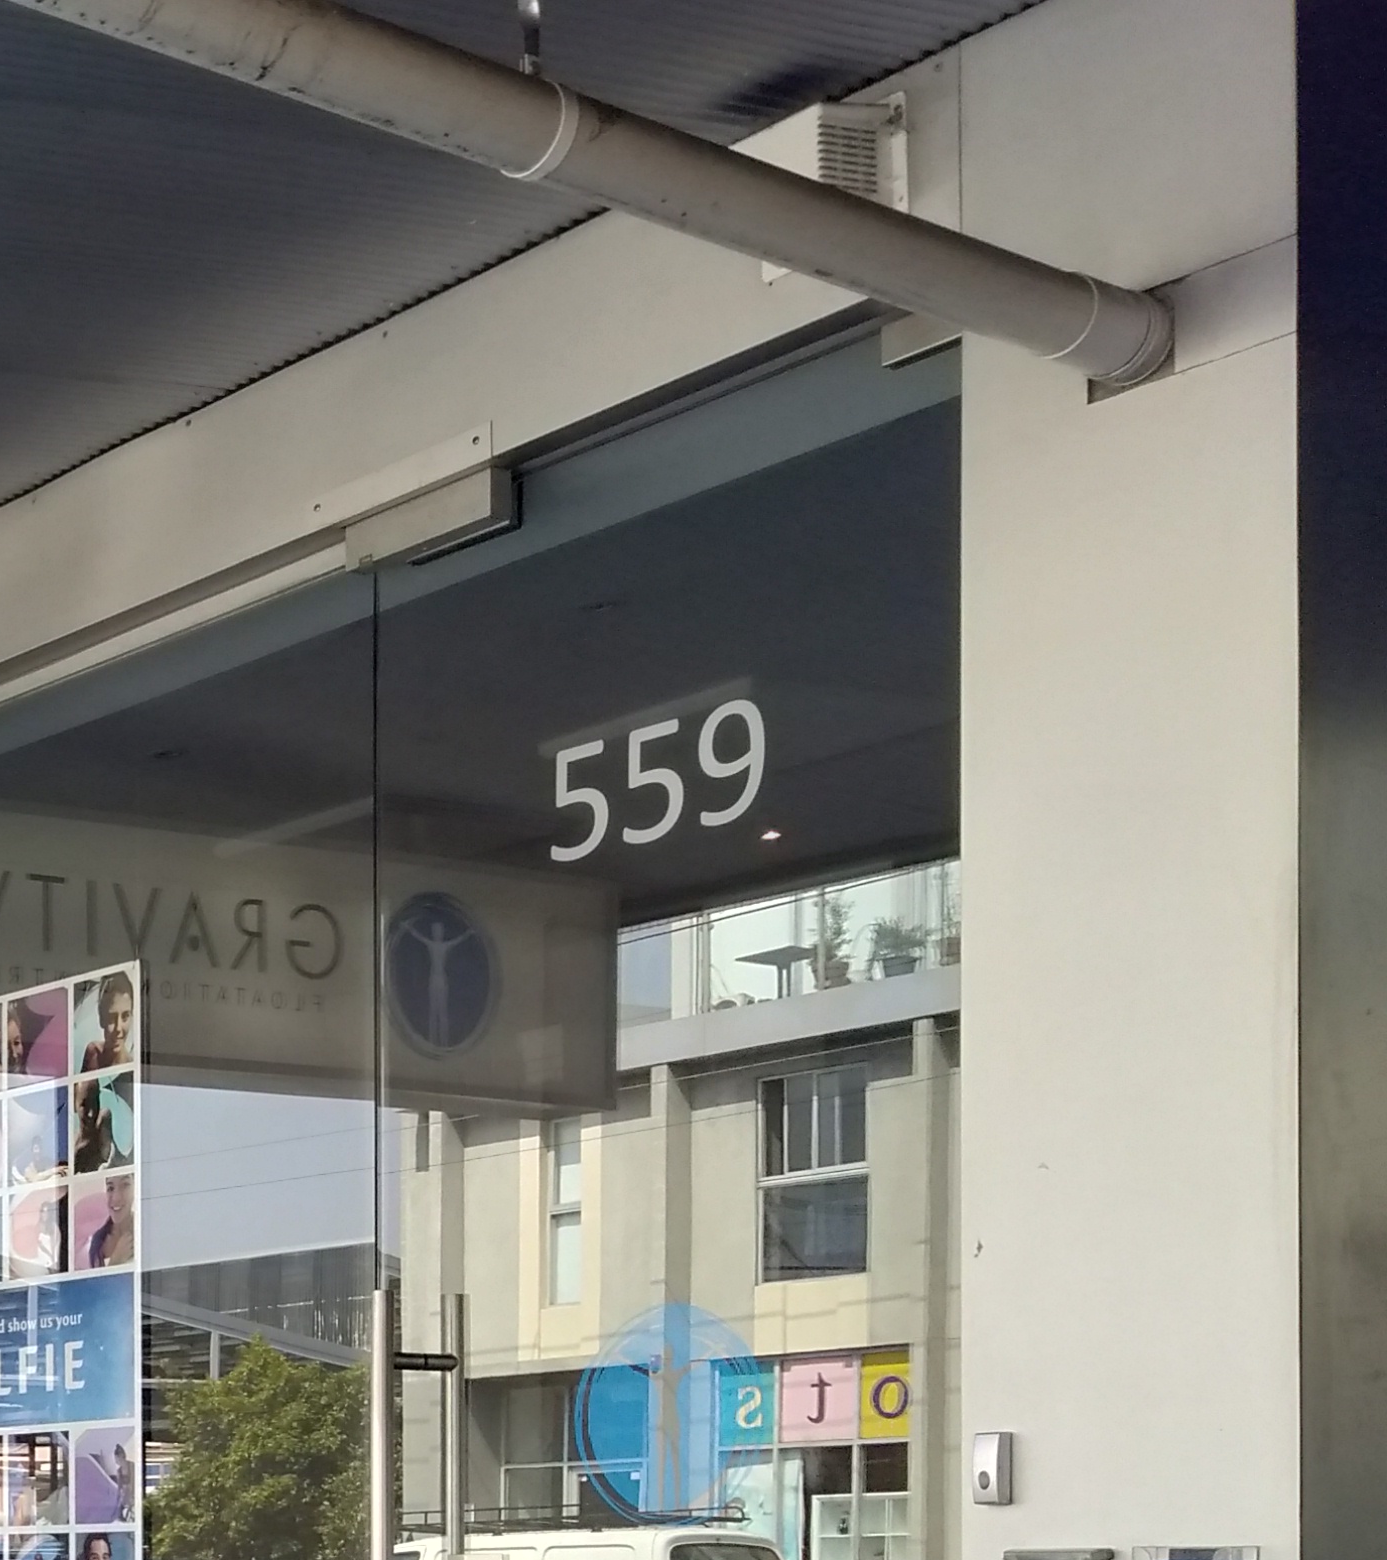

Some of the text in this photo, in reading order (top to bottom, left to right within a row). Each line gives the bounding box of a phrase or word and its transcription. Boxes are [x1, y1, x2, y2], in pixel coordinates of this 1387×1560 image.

[550, 698, 766, 862] 559
[7, 1314, 37, 1333] show
[39, 1316, 54, 1329] us
[55, 1312, 83, 1331] your
